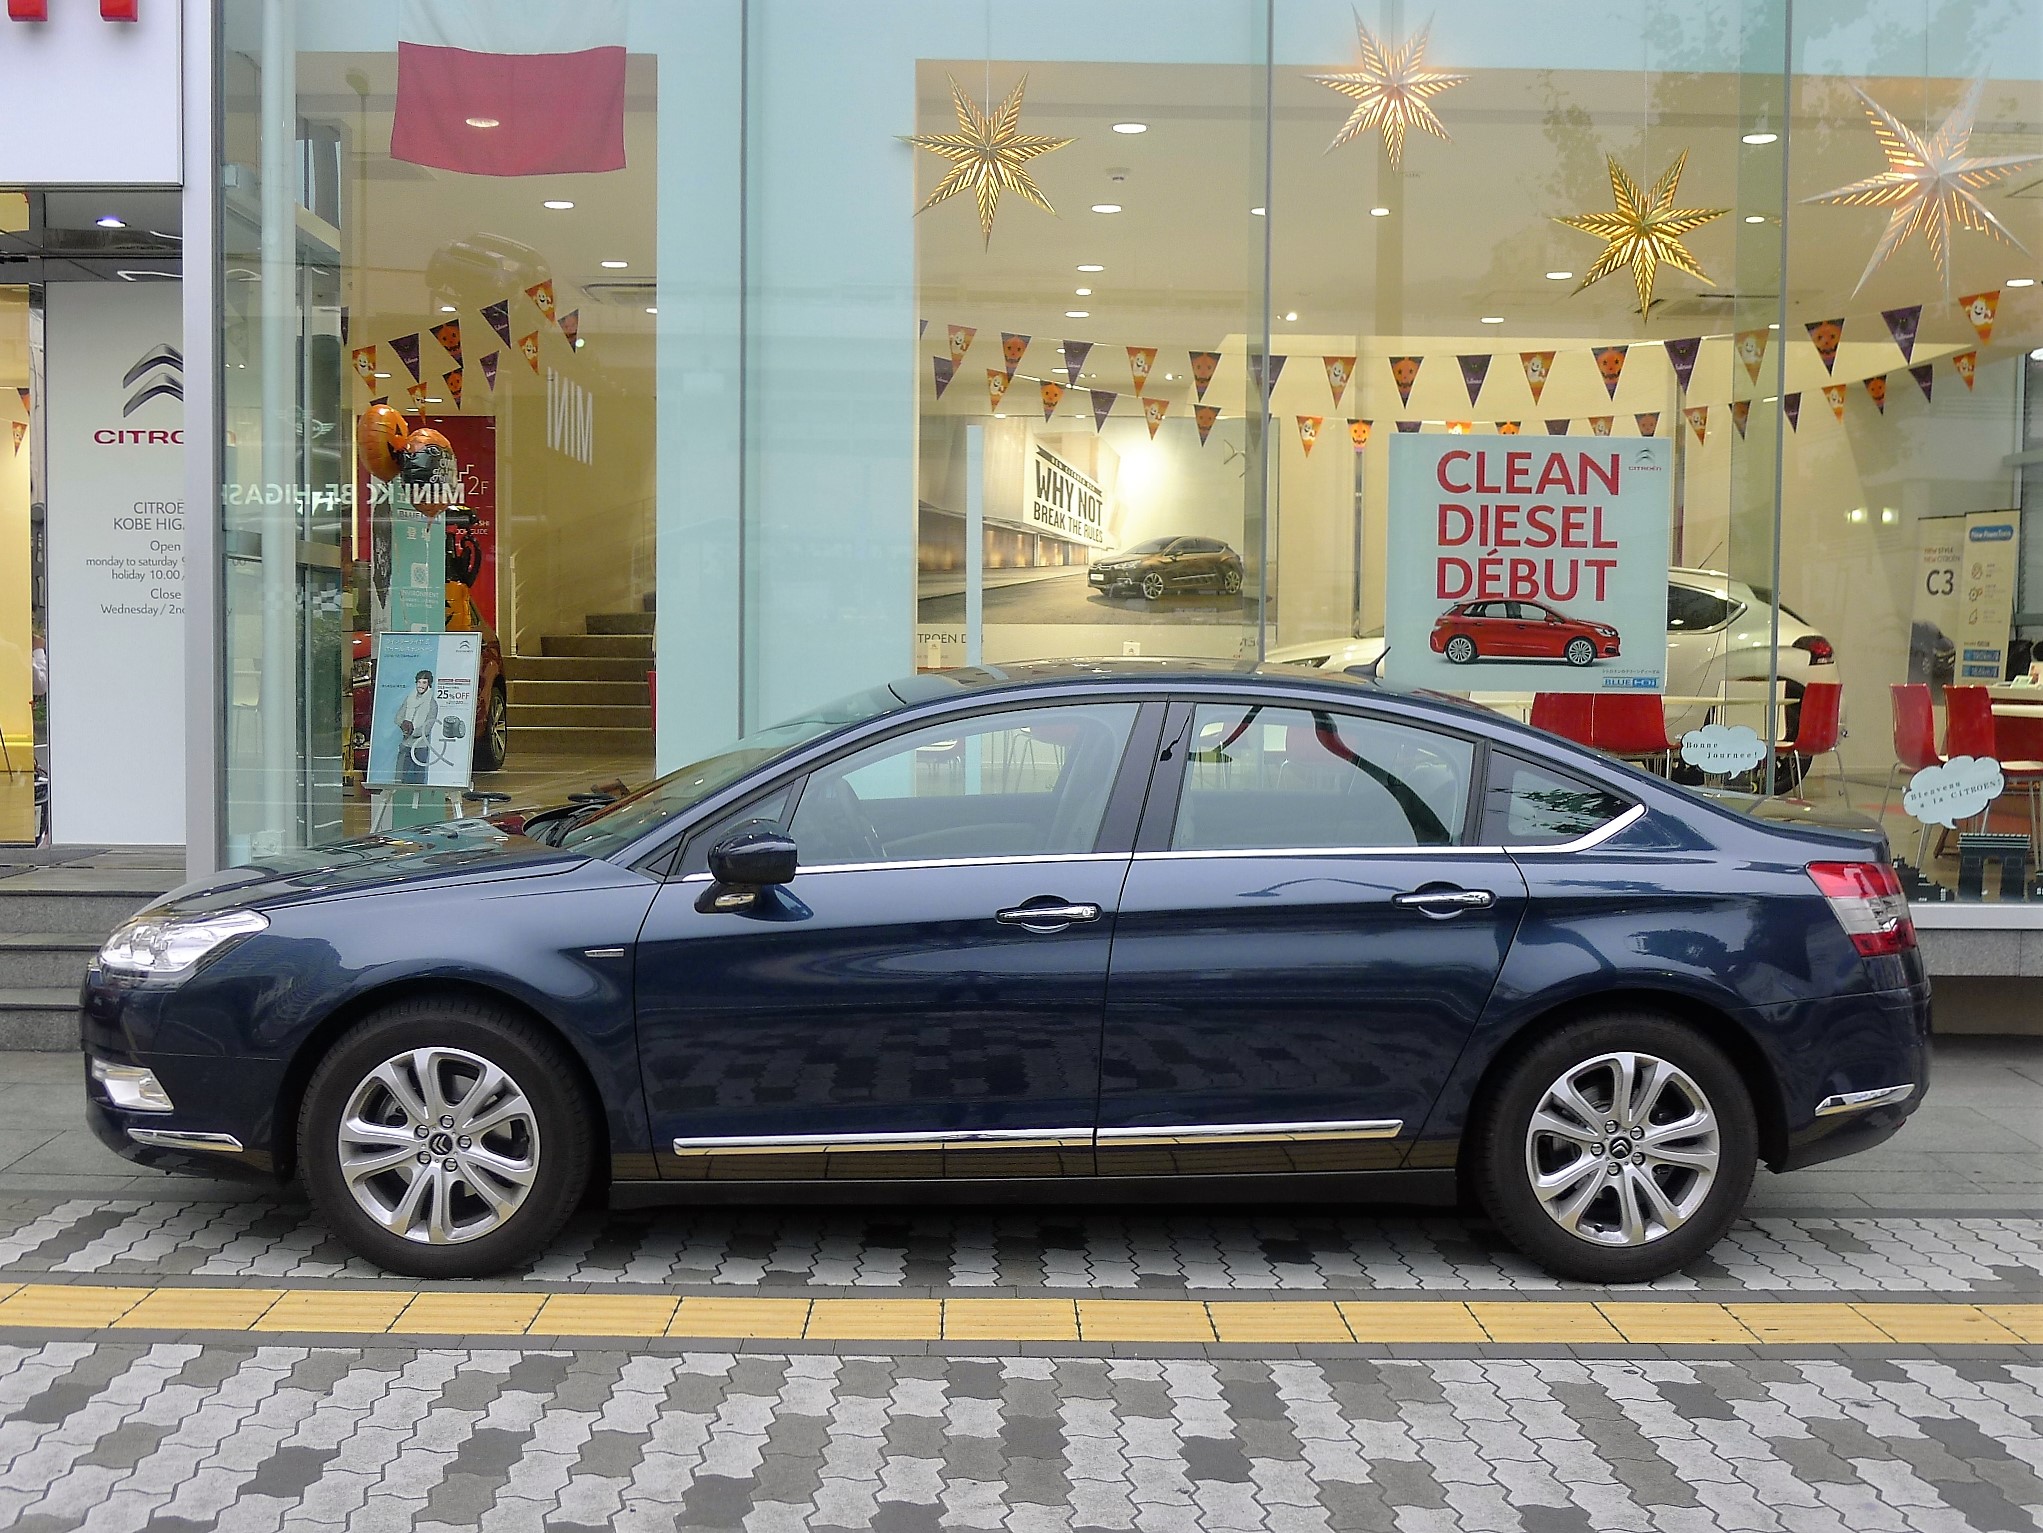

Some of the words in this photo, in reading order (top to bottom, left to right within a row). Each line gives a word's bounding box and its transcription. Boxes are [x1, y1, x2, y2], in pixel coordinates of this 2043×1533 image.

[1437, 450, 1620, 496] CLEAN
[468, 475, 489, 495] 2F
[1035, 458, 1075, 513] WHY
[1078, 487, 1103, 527] NOT
[113, 518, 152, 530] KOBE
[1033, 501, 1066, 531] BREAK
[1068, 516, 1082, 536] THE
[1083, 523, 1103, 544] RULES
[1437, 504, 1618, 549] DIESEL
[150, 540, 181, 554] Open
[86, 555, 124, 568] monday
[126, 558, 136, 566] to
[138, 555, 177, 568] saturday
[111, 569, 145, 582] holiday
[150, 570, 180, 580] 10.00
[1436, 548, 1618, 602] DÉBUT
[1926, 569, 1954, 596] C3
[150, 588, 182, 600] Close
[100, 604, 158, 617] Wednesday
[1686, 741, 1718, 749] Bonne
[1909, 781, 1961, 801] Bienvenu
